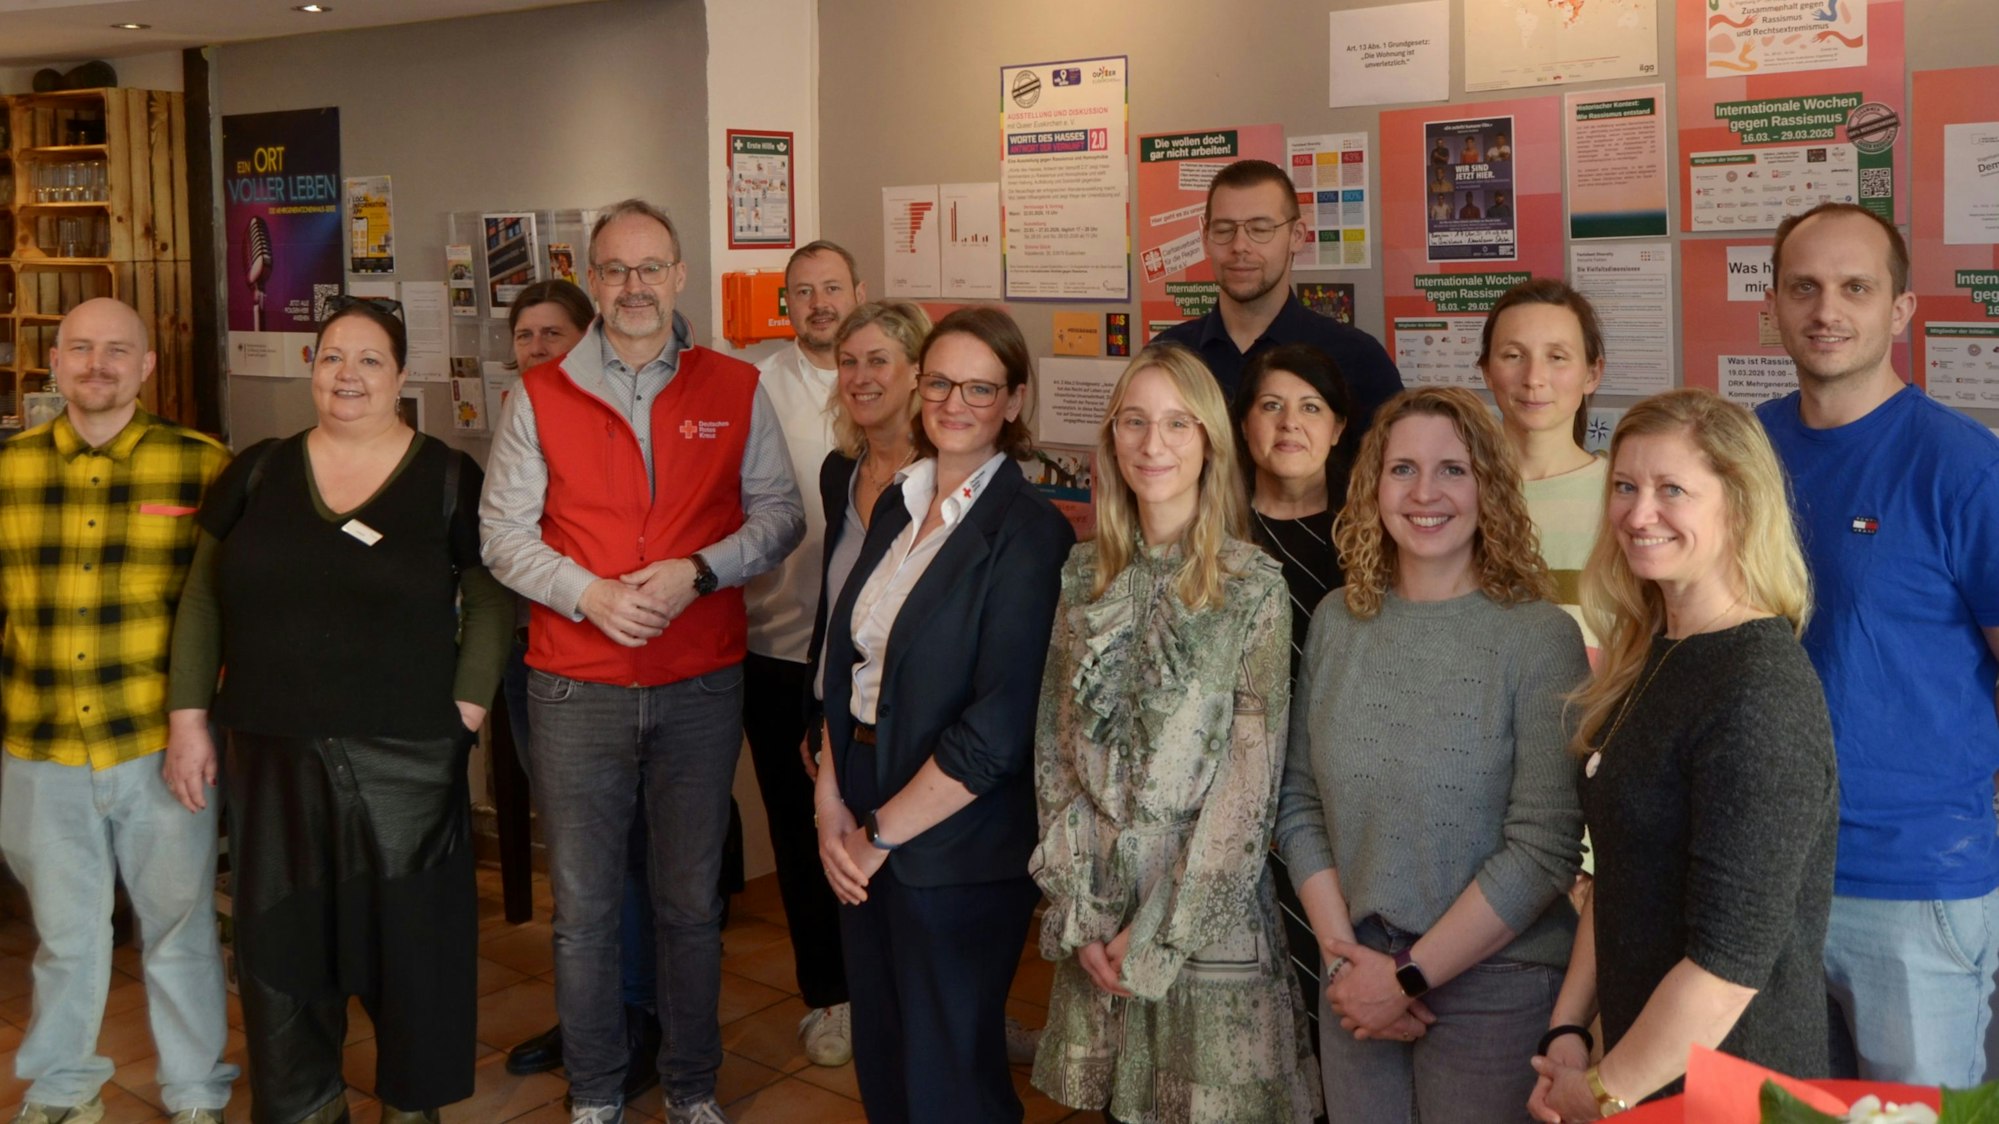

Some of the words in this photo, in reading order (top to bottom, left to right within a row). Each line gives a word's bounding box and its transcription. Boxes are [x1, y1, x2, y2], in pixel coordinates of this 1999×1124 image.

[1741, 3, 1799, 15] Zusammenhalt
[1800, 1, 1824, 11] gegen
[1762, 14, 1802, 24] Rassismus
[1736, 29, 1751, 37] und
[1753, 23, 1829, 36] Rechtsextremismus
[1388, 39, 1431, 49] Grundgesetz:
[1376, 50, 1406, 58] Wohnung
[1623, 107, 1651, 117] entstand
[1715, 100, 1801, 117] Internationale
[1803, 95, 1858, 111] Wochen
[1007, 110, 1052, 121] AUSSTELLUNG
[1053, 109, 1067, 118] UND
[1068, 107, 1109, 117] DISKUSSION
[1730, 116, 1769, 132] gegen
[1771, 112, 1843, 127] Rassismus
[1009, 133, 1037, 145] WORTE
[1038, 133, 1053, 143] DES
[1054, 131, 1085, 142] HASSES
[1154, 138, 1170, 149] Die
[1171, 136, 1201, 147] wollen
[1202, 134, 1226, 145] doch
[1742, 132, 1771, 143] 16.03.
[1780, 128, 1834, 142] 29.03.2026
[746, 142, 762, 150] Erste
[1149, 151, 1165, 161] gar
[1166, 148, 1189, 158] nicht
[1191, 144, 1231, 156] arbeiten!
[236, 161, 251, 174] EIN
[254, 146, 285, 173] ORT
[1455, 165, 1470, 173] WIR
[1471, 163, 1489, 172] SIND
[1978, 161, 1999, 173] Dem
[1455, 172, 1474, 181] JETZT
[1476, 171, 1496, 179] HIER.
[227, 176, 285, 204] VOLLER
[288, 173, 337, 201] LEBEN
[1728, 261, 1759, 275] Was
[1415, 275, 1483, 287] Internationale
[1485, 273, 1528, 286] Wochen
[1957, 272, 1999, 285] Intern
[1166, 283, 1220, 293] Internationale
[1745, 281, 1769, 293] mir
[1175, 296, 1200, 306] gegen
[1201, 294, 1218, 304] Ras
[1426, 290, 1458, 301] gegen
[1459, 287, 1506, 299] Rassism
[1973, 290, 1999, 303] geg
[1183, 307, 1201, 316] 16.03.
[1437, 303, 1460, 312] 16.03.
[1467, 302, 1495, 311] 29.03.
[768, 318, 791, 327] Erste
[1727, 358, 1746, 366] Was
[1748, 357, 1759, 366] ist
[1728, 369, 1765, 377] 19.03.2026
[1728, 380, 1745, 388] DRK
[1746, 380, 1800, 389] Mehrgeneratio
[1728, 391, 1771, 399] Kommerner
